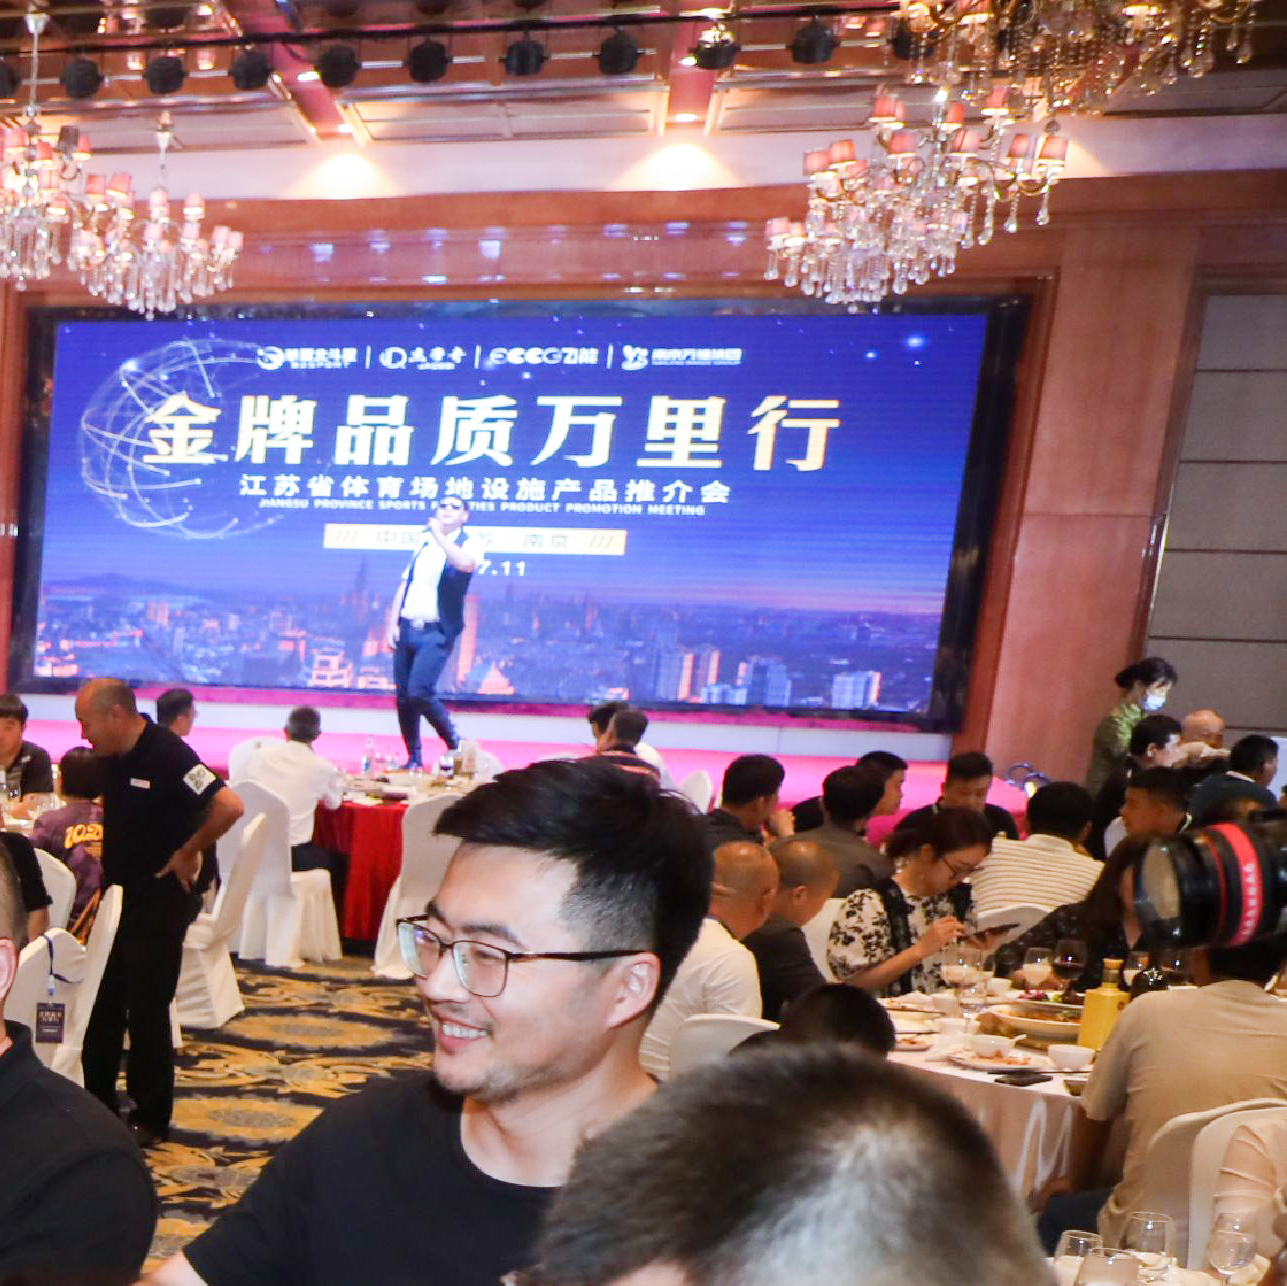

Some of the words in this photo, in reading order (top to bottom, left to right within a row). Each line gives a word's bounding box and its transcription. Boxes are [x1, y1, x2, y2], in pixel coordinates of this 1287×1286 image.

[142, 393, 841, 473] 金牌品质万里行
[239, 473, 731, 503] 江苏省体育场地设施产品推介会
[259, 498, 309, 509] JIANGSU
[314, 499, 374, 510] PROVINCE
[378, 500, 426, 511] SPORTS
[500, 502, 560, 513] PRODUCT
[565, 503, 643, 515] PROMOTION
[647, 504, 706, 516] MEETING
